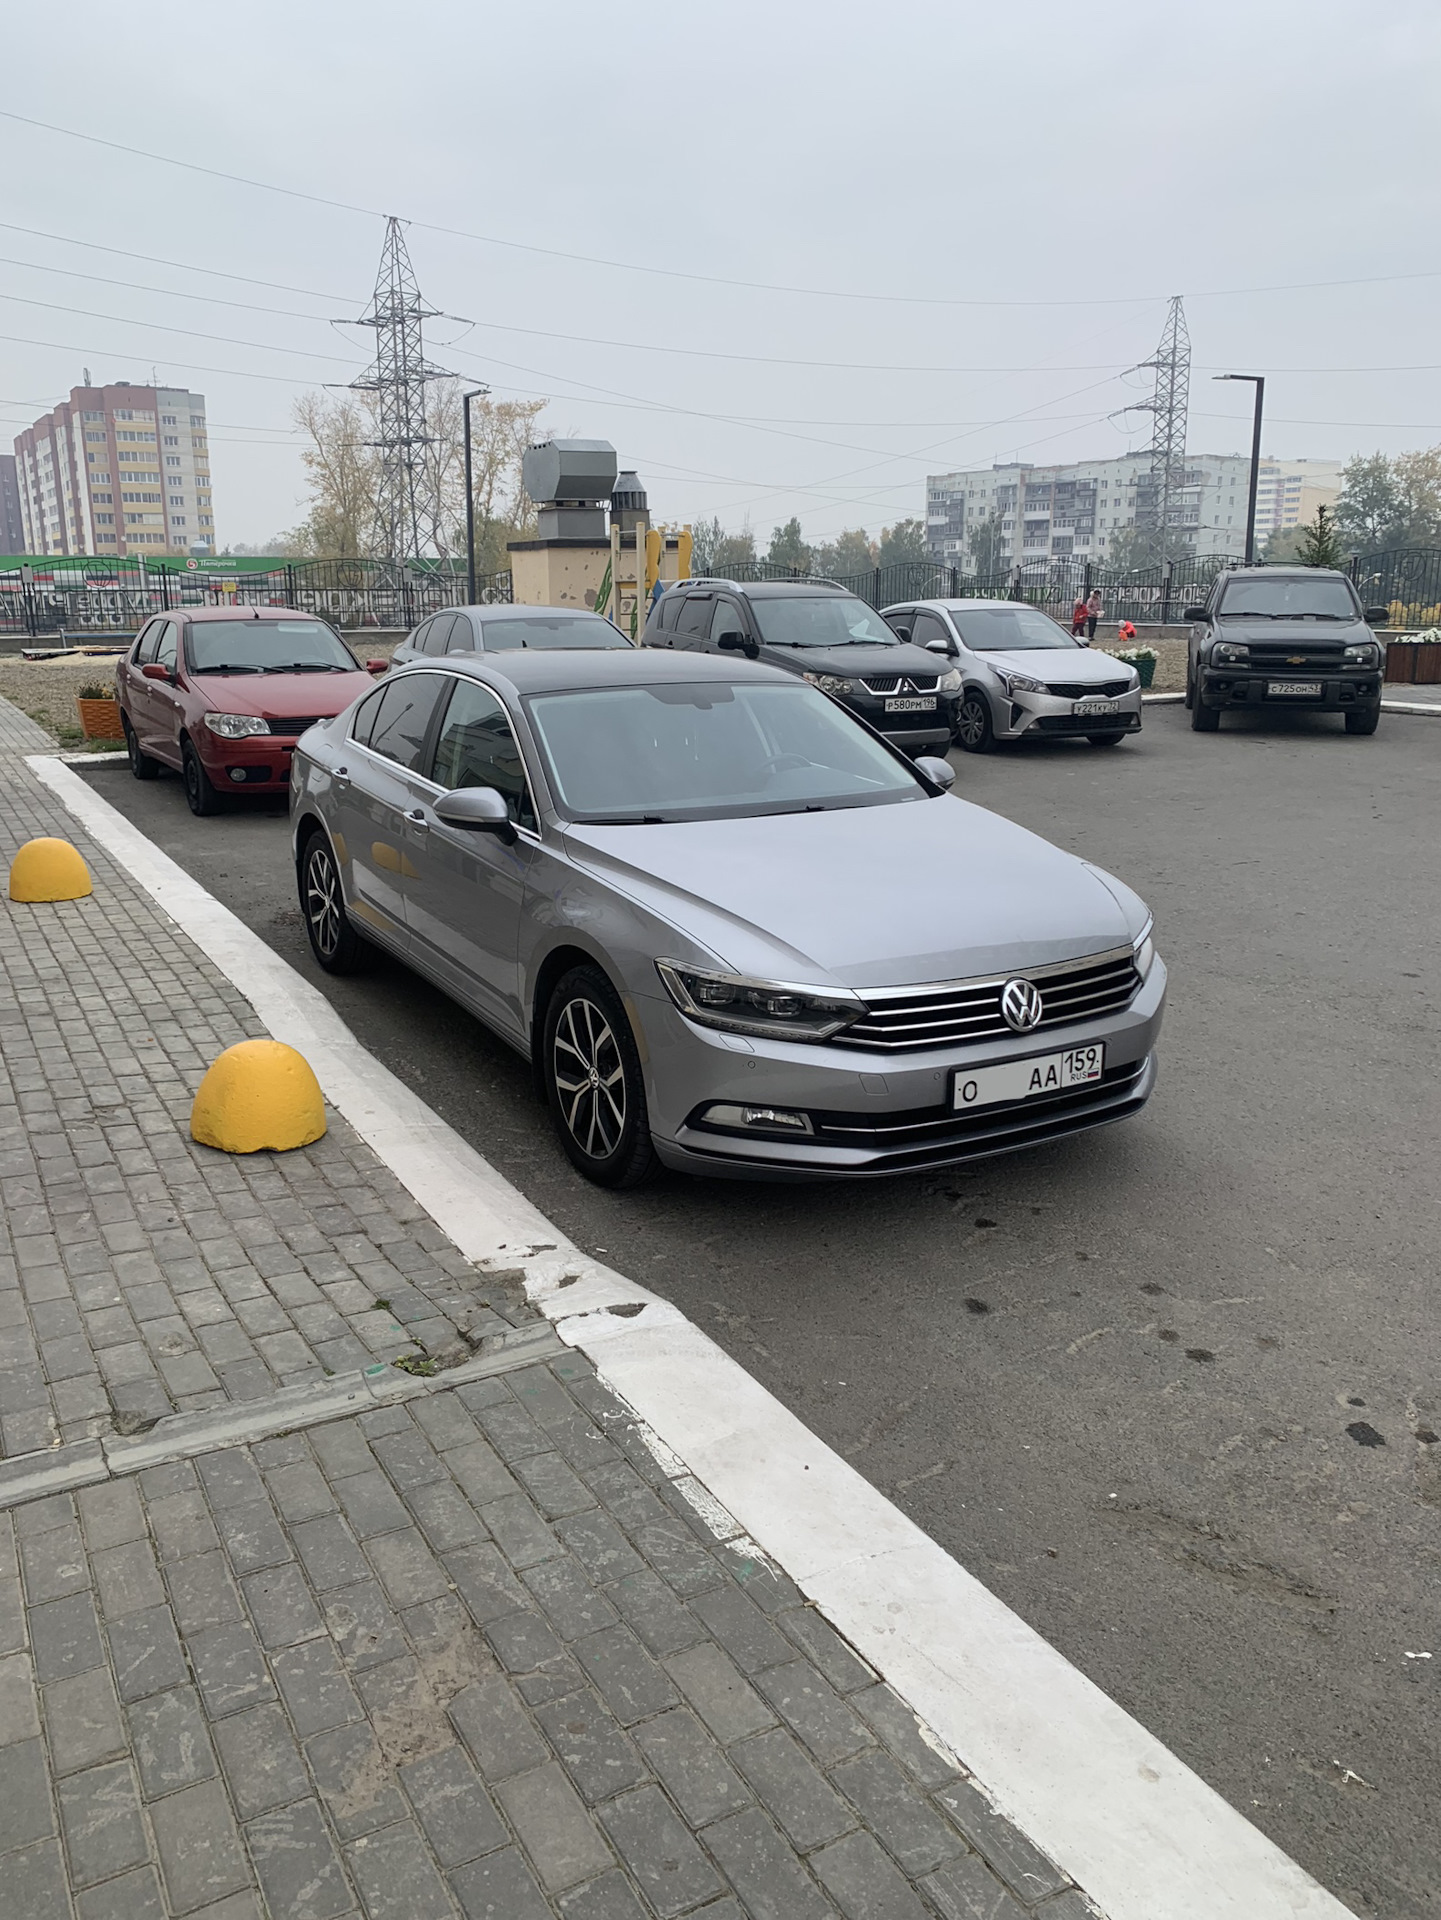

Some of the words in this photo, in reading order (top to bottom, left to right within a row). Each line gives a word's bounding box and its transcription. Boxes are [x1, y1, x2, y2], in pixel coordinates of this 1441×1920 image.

[887, 700, 921, 710] Р580РМ
[923, 698, 935, 706] 196
[1064, 1048, 1096, 1073] 159
[1070, 1071, 1087, 1082] RUS
